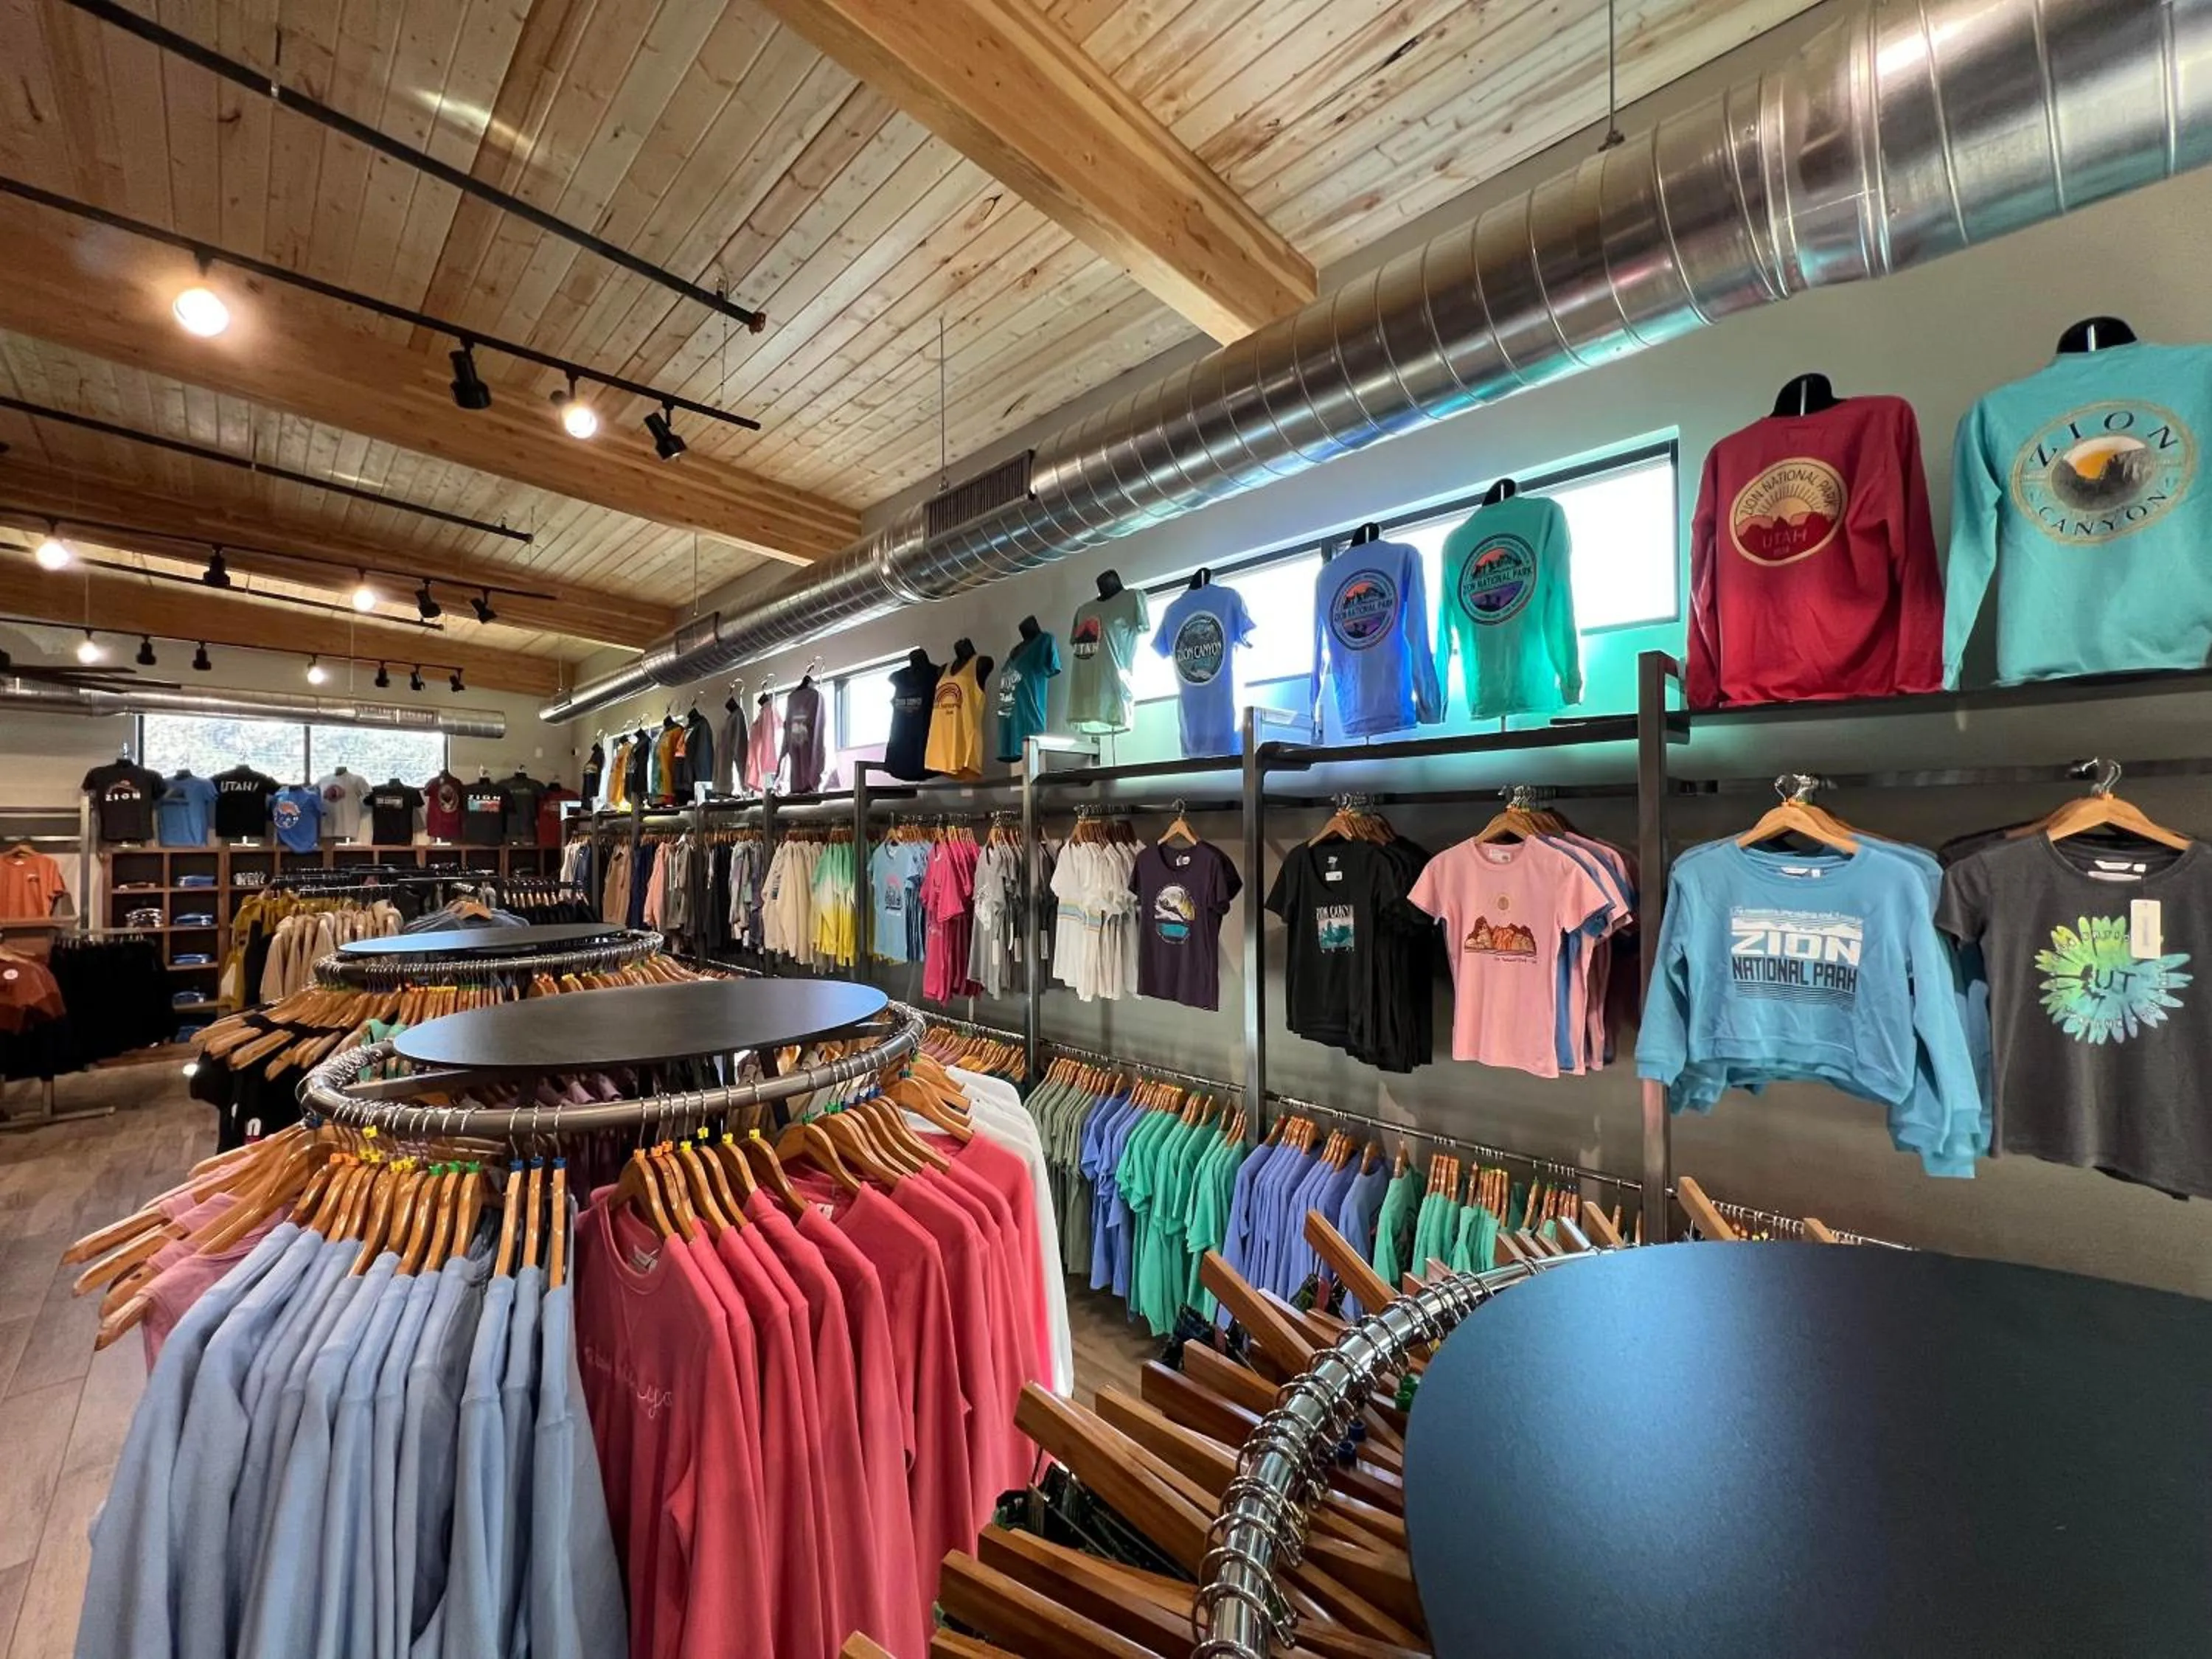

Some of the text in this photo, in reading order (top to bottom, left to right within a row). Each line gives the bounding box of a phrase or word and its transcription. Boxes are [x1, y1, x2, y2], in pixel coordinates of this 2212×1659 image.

[2029, 411, 2179, 467] ZION
[1761, 468, 1818, 492] NATIONAL
[2039, 490, 2168, 536] CANYON
[1762, 529, 1806, 549] UTAH
[105, 793, 141, 801] ZION
[1731, 930, 1862, 967] ZION
[1732, 956, 1858, 992] NATIONAL PARK
[2095, 969, 2137, 993] UT
